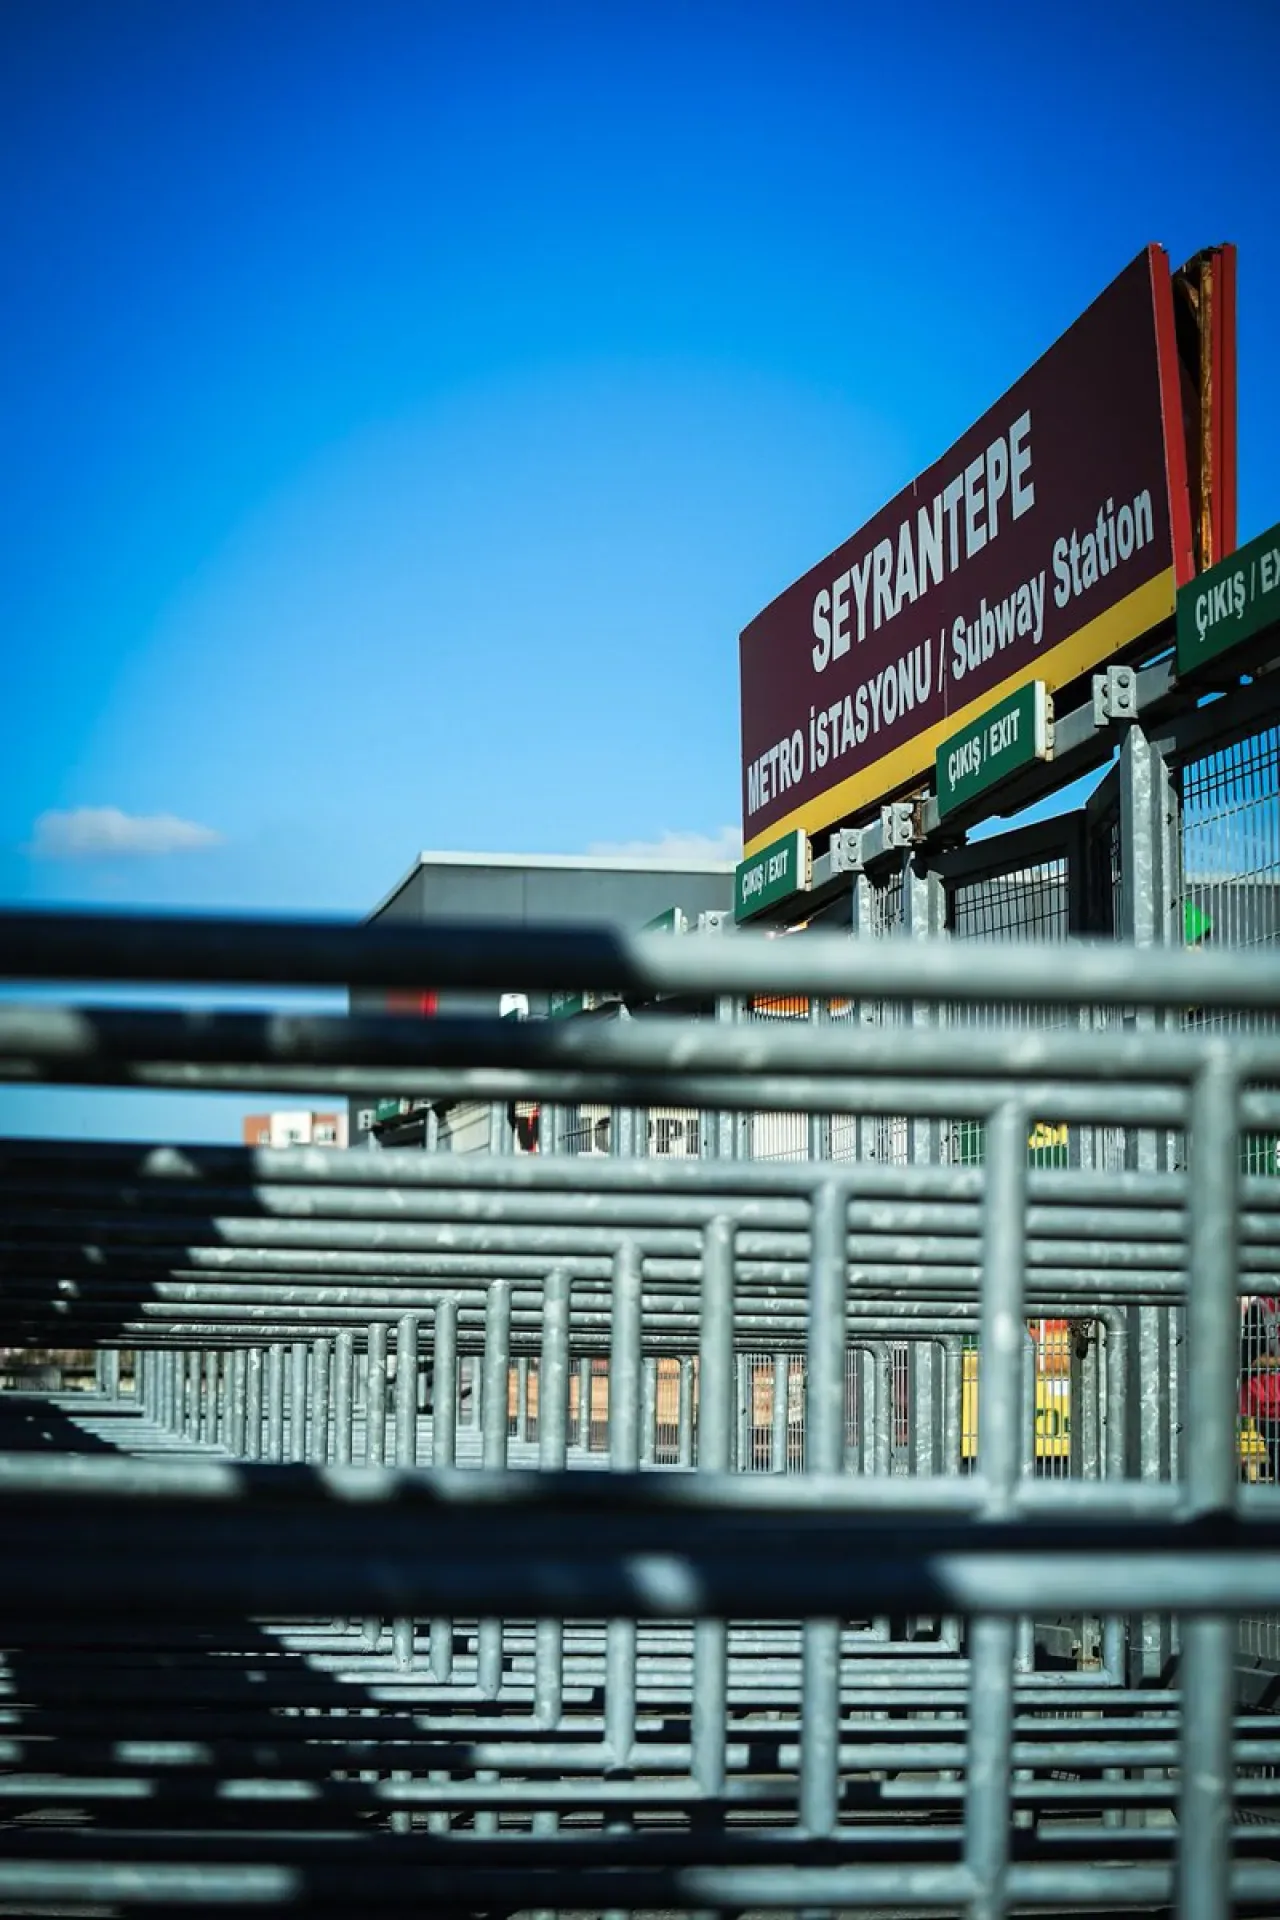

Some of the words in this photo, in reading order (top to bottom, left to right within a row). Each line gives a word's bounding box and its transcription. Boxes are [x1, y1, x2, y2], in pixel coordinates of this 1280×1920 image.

[812, 410, 1035, 672] SEYRANTEPE
[1195, 570, 1246, 643] ÇIKIŞ
[1250, 561, 1256, 602] /
[747, 729, 804, 816] METRO
[810, 640, 932, 772] İSTASYONU
[938, 629, 946, 693] /
[951, 571, 1046, 681] Subway
[1053, 489, 1153, 609] Station
[948, 736, 981, 792] ÇIKIŞ
[983, 729, 988, 762] /
[990, 707, 1020, 756] EXIT
[769, 848, 789, 883] EXIT
